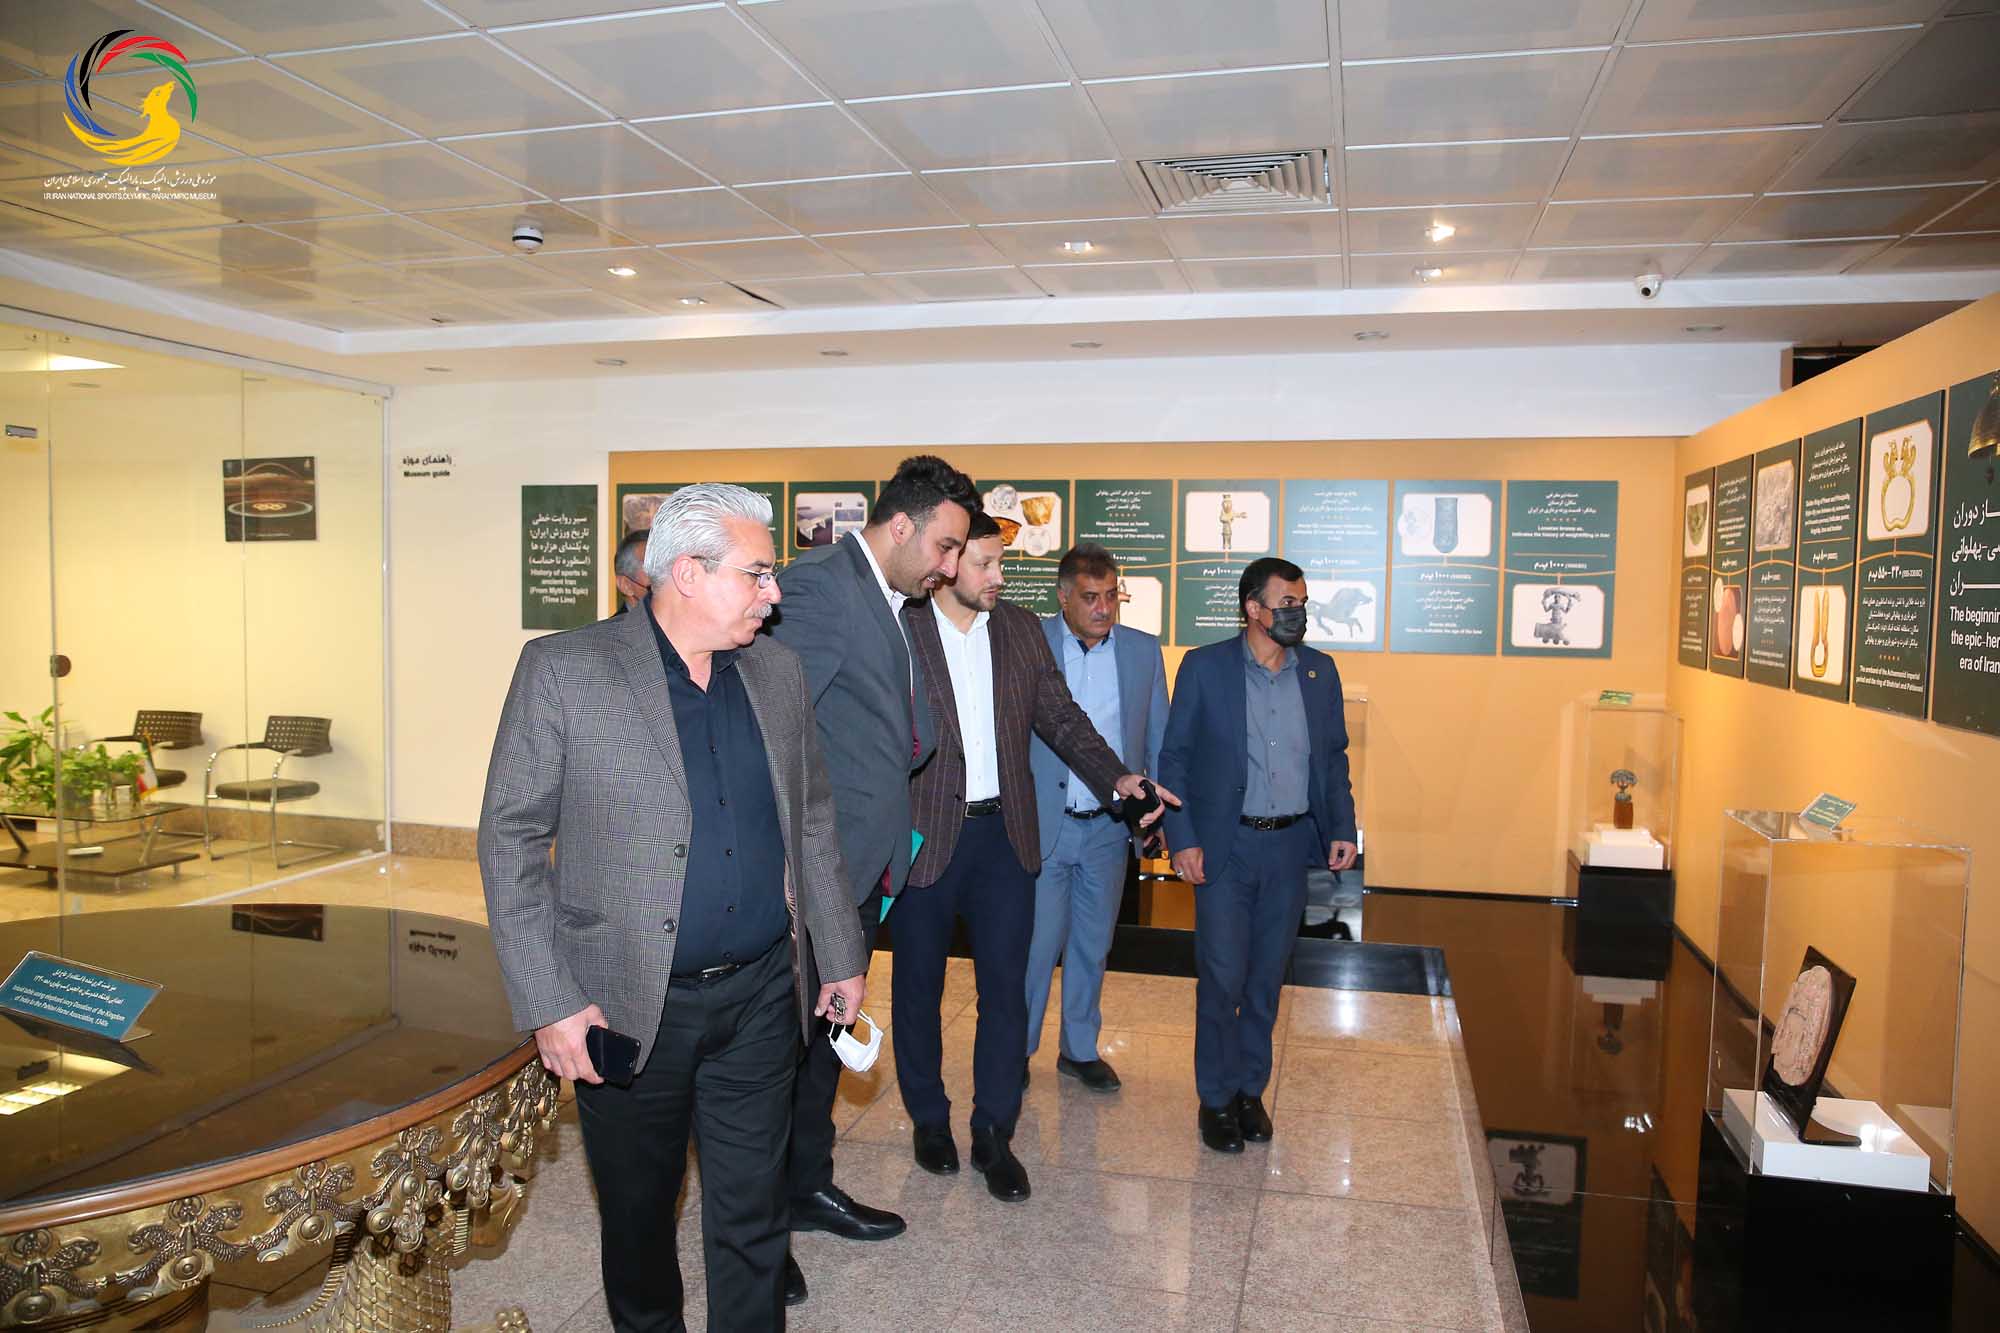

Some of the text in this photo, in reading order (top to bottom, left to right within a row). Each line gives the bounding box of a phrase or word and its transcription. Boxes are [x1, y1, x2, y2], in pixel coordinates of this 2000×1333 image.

[403, 454, 452, 467] راهنمای موزه
[531, 513, 588, 525] سیر روایت خطی
[1953, 501, 1979, 529] دوران
[549, 528, 570, 539] ورزش
[571, 527, 590, 539] تاریخ
[531, 541, 539, 550] ها
[540, 542, 558, 553] هزاره
[582, 544, 590, 553] به
[555, 555, 561, 565] تا
[530, 569, 552, 577] History
[1949, 606, 1965, 622] The
[1951, 629, 1964, 645] the
[1959, 657, 1973, 670] era
[1973, 656, 1983, 671] of
